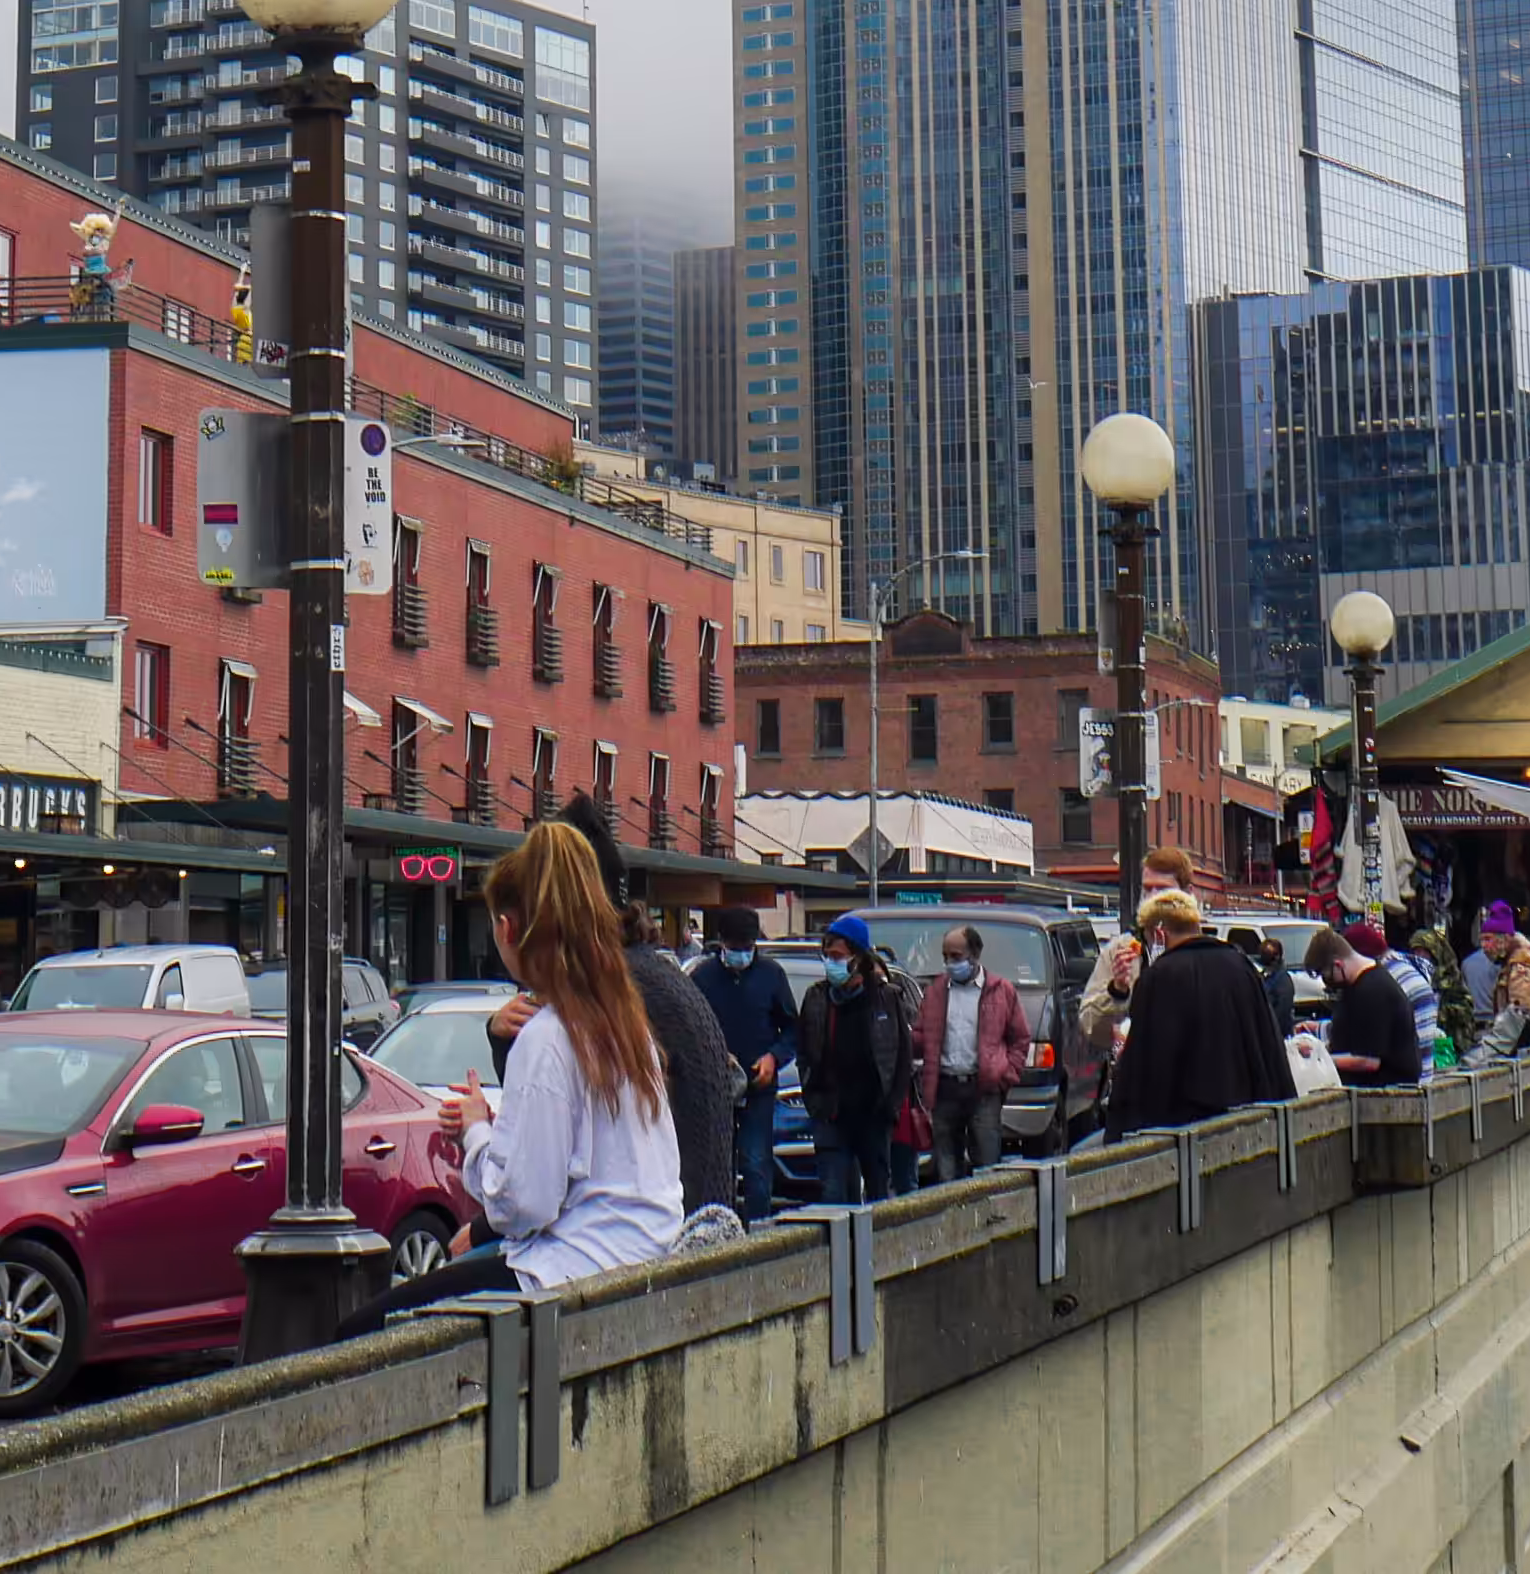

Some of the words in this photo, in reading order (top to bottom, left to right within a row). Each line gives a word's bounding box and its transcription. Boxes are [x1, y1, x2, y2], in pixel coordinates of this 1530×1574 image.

[367, 467, 379, 478] BE
[365, 478, 382, 490] THE
[364, 491, 386, 503] VOID
[1401, 816, 1432, 826] OCALLY
[1434, 816, 1482, 826] HANDMADE
[1484, 816, 1516, 826] CRAFTS
